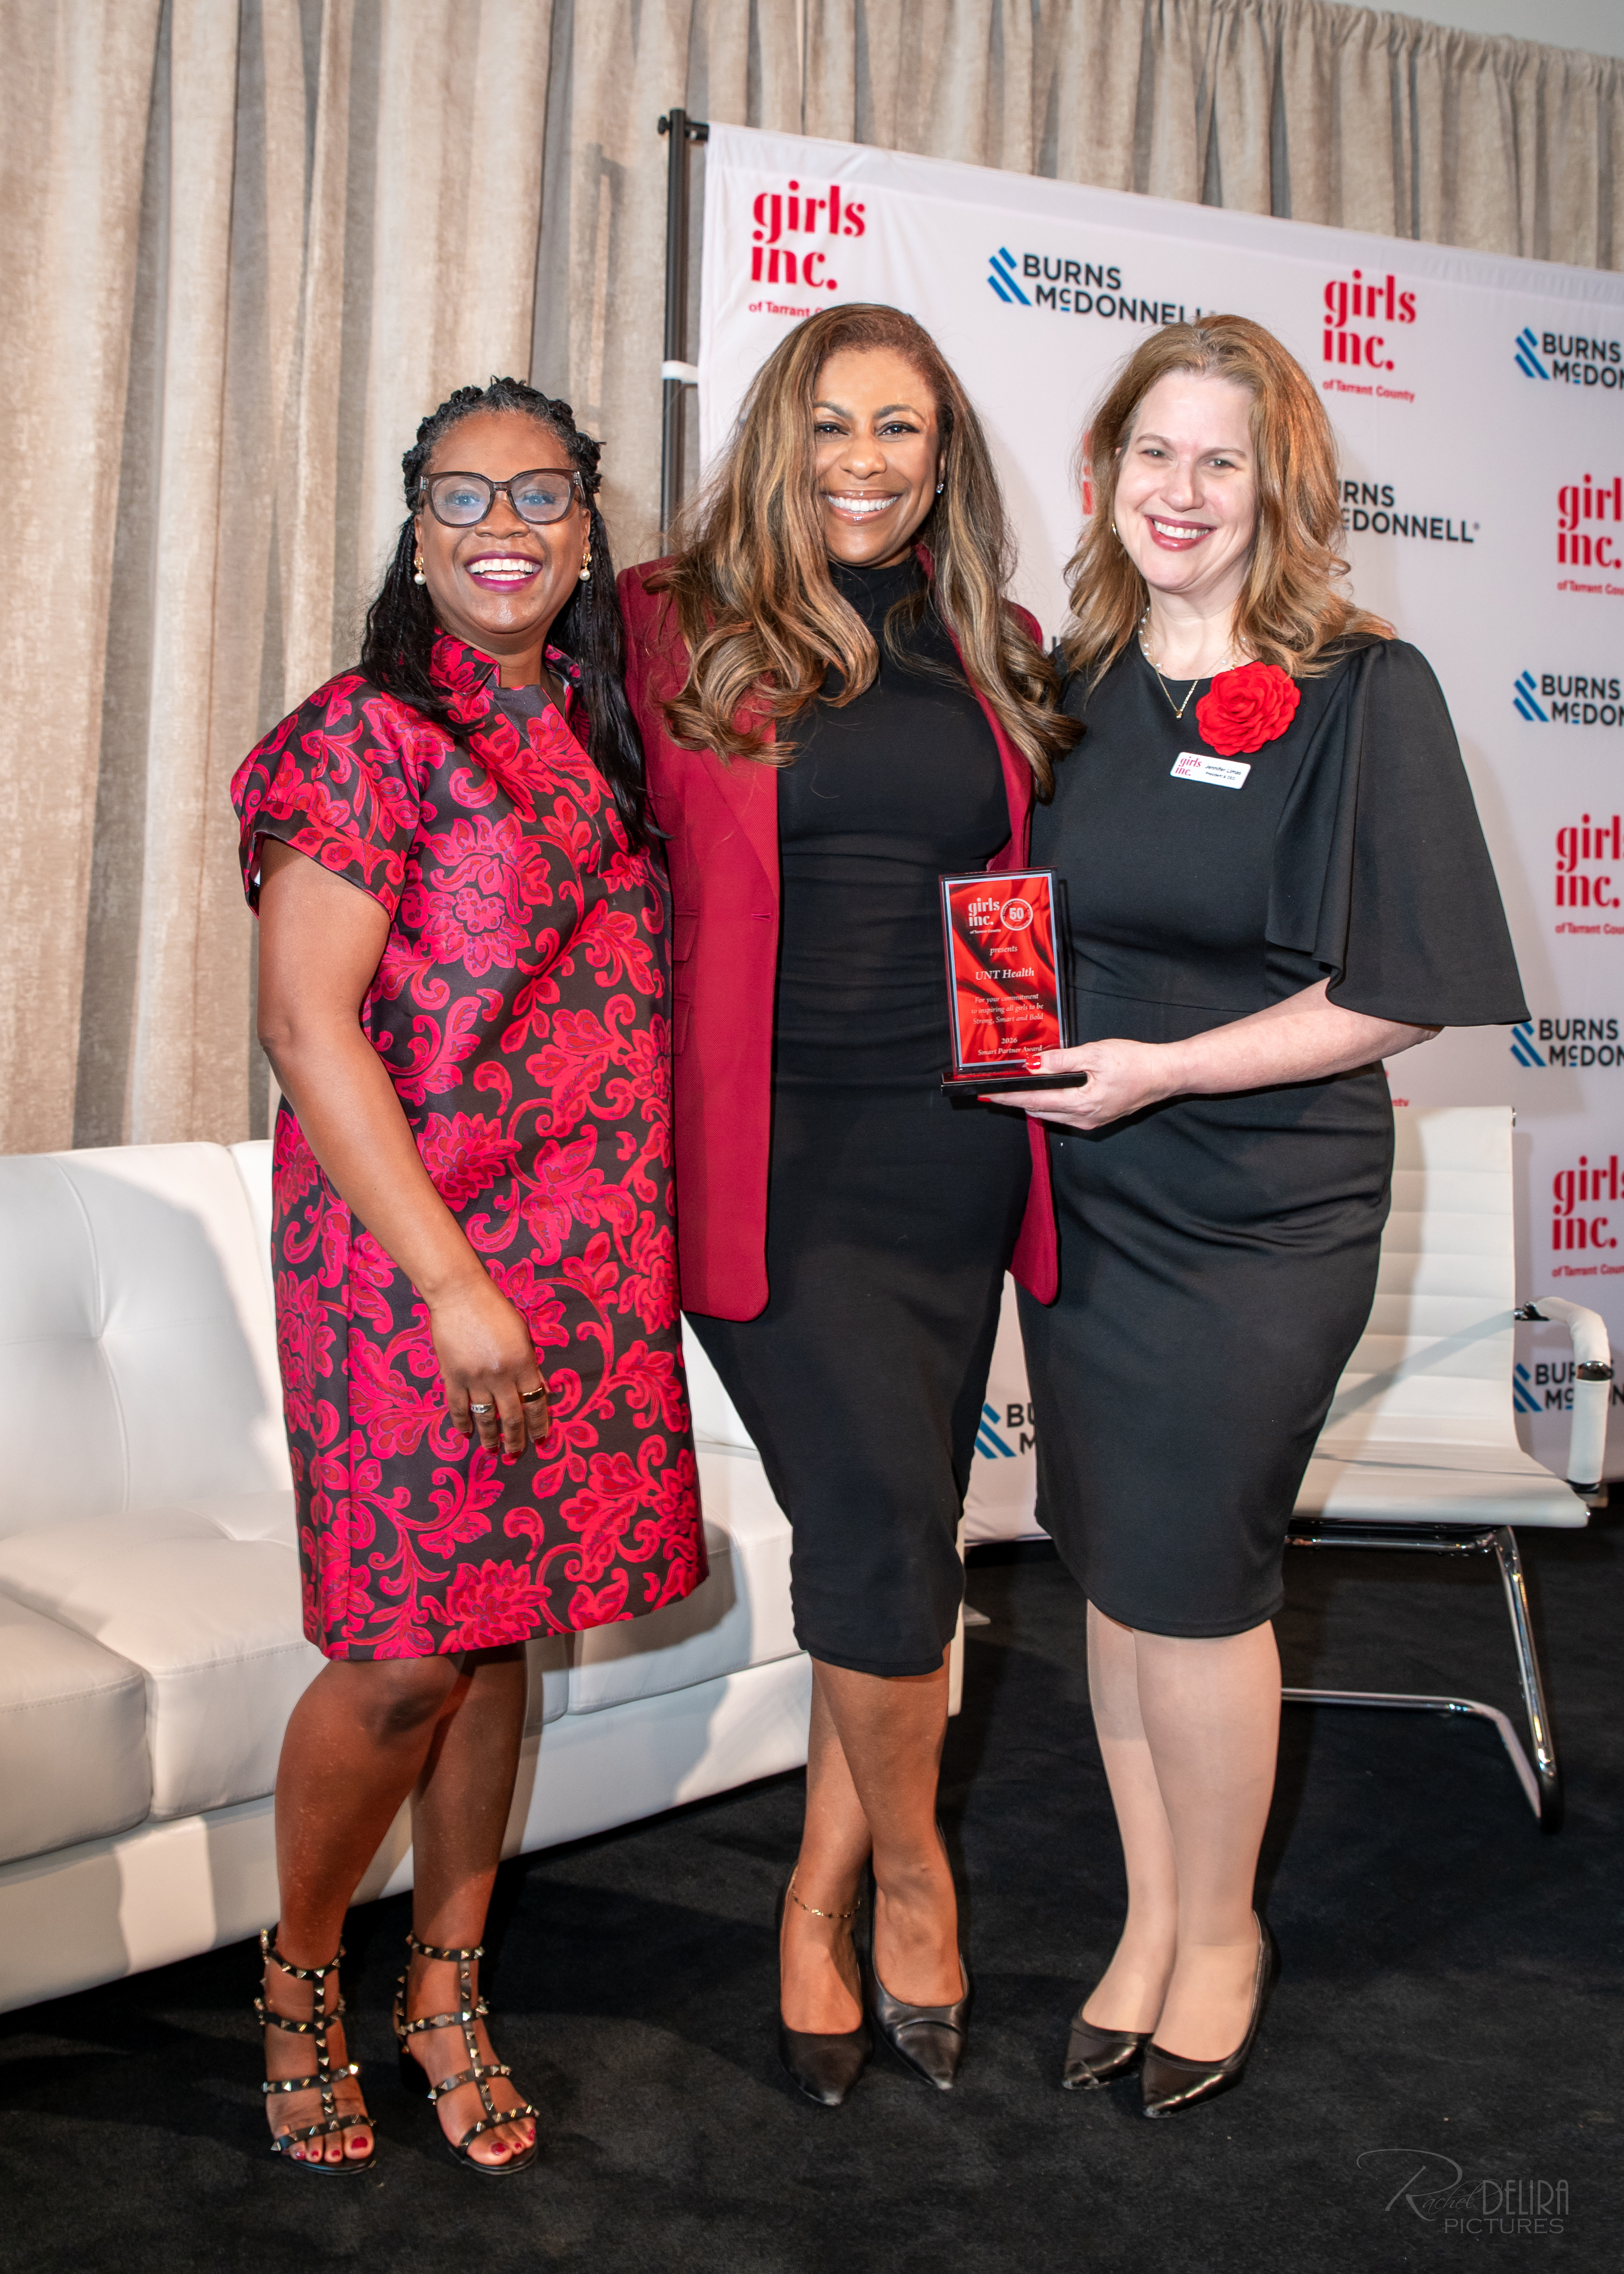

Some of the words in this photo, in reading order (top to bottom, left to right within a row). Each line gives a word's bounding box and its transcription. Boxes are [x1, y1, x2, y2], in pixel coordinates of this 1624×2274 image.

[753, 180, 865, 245] girls
[752, 247, 837, 291] inc.
[1024, 253, 1121, 291] BURNS
[748, 301, 762, 312] of
[766, 302, 810, 317] Tarrant
[1323, 269, 1416, 329] girls
[1323, 329, 1395, 371] inc.
[1542, 332, 1621, 364] BURNS
[1322, 379, 1334, 390] of
[1336, 379, 1373, 396] Tarrant
[1376, 385, 1414, 403] County
[1338, 480, 1395, 507] RNS
[1341, 508, 1474, 543] DONNELL
[1557, 533, 1622, 570] inc.
[1557, 580, 1568, 591] of
[1569, 580, 1603, 594] Tarrant
[1541, 674, 1621, 700] BURNS
[1178, 757, 1202, 768] girls
[1555, 813, 1624, 873] girl
[1555, 874, 1621, 909] inc.
[968, 897, 1000, 917] girls
[1009, 907, 1024, 920] 50
[969, 916, 994, 926] inc.
[1555, 922, 1566, 934] of
[1566, 922, 1601, 935] Tarrant
[989, 946, 1017, 956] presents
[975, 970, 1000, 980] UNT
[1002, 967, 1035, 978] Health
[978, 1007, 1005, 1015] inspiring
[1015, 1004, 1028, 1013] girls
[1539, 1019, 1619, 1041] BURNS
[1552, 1154, 1624, 1217] girl
[1552, 1217, 1617, 1251] inc.
[1551, 1266, 1563, 1278] of
[1564, 1265, 1598, 1277] Tarrant
